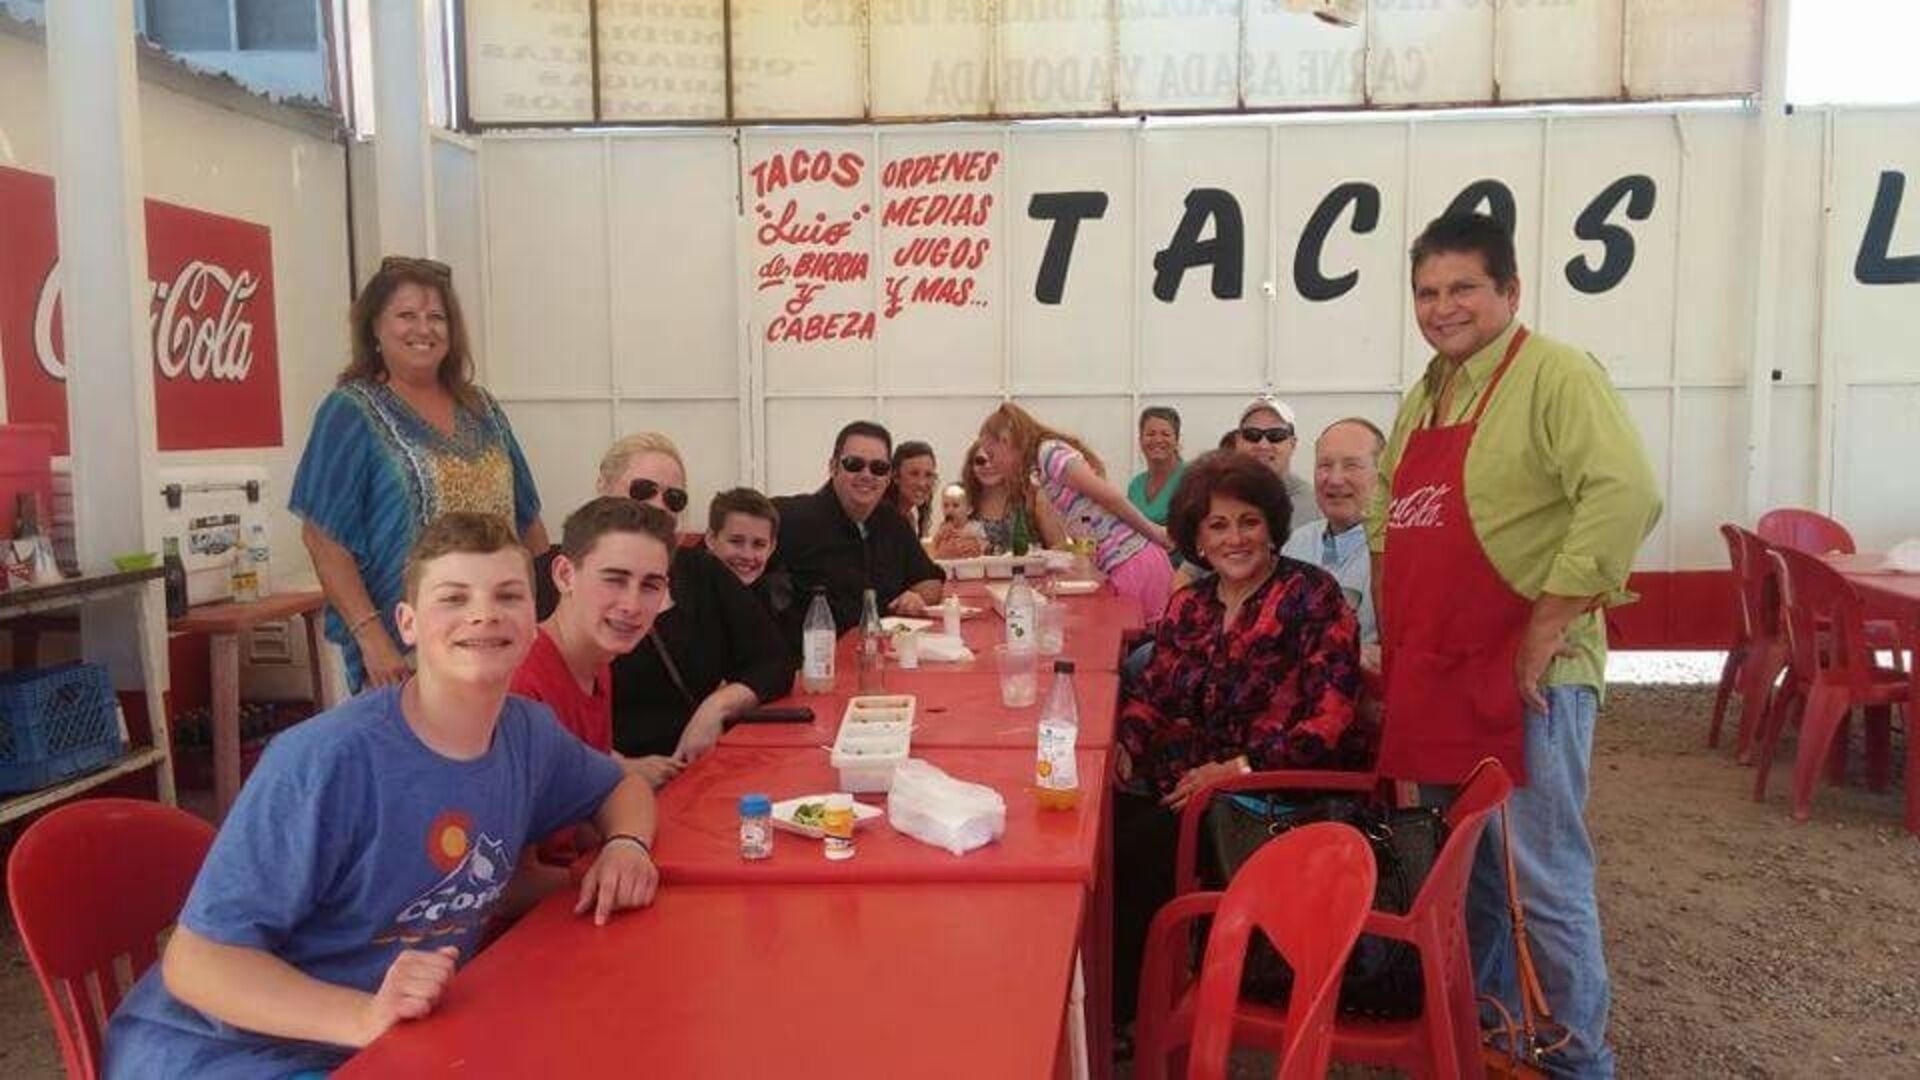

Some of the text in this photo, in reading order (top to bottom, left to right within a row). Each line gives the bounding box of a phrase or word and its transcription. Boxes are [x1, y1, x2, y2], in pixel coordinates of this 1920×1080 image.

[752, 149, 865, 198] TACOS
[882, 151, 1000, 190] ORDENES
[882, 193, 993, 228] MEDIAS
[793, 251, 869, 283] BIRRIA
[893, 237, 990, 270] JUGOS
[767, 312, 877, 343] CABEZA
